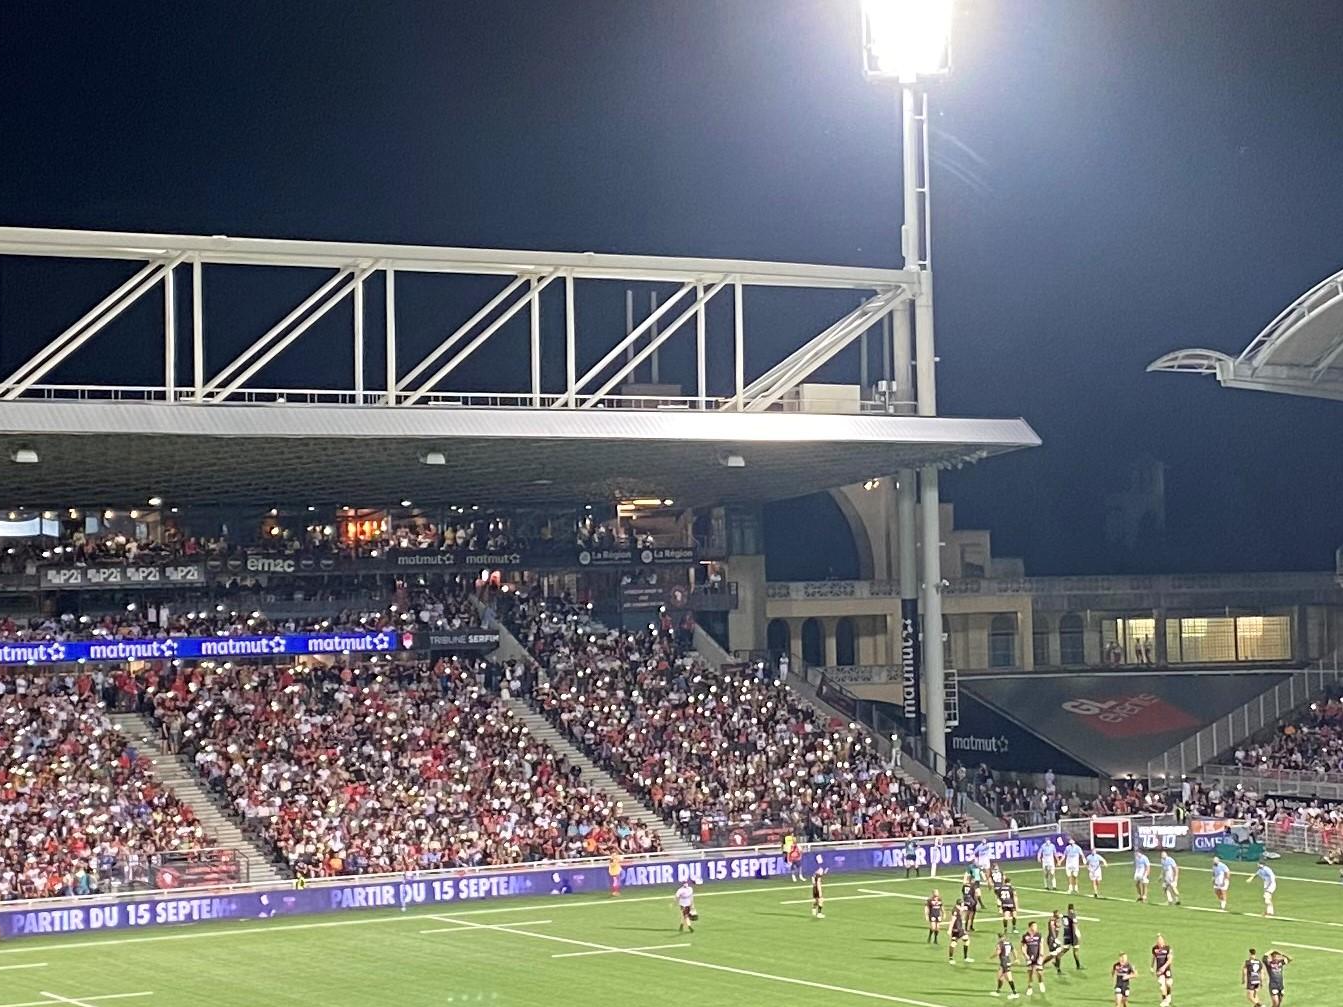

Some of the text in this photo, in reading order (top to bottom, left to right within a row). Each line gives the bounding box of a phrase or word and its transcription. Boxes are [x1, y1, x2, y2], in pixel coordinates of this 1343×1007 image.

[247, 556, 295, 573] em2c
[90, 641, 160, 659] matmut
[202, 638, 271, 656] matmut
[308, 634, 374, 651] matmut
[902, 637, 916, 718] matmut
[953, 736, 998, 751] matmut
[708, 860, 727, 879] 15
[331, 885, 395, 909] PARTIR
[432, 880, 454, 900] 15
[12, 906, 85, 935] PARTIR
[90, 904, 119, 929] DU
[127, 903, 150, 925] 15
